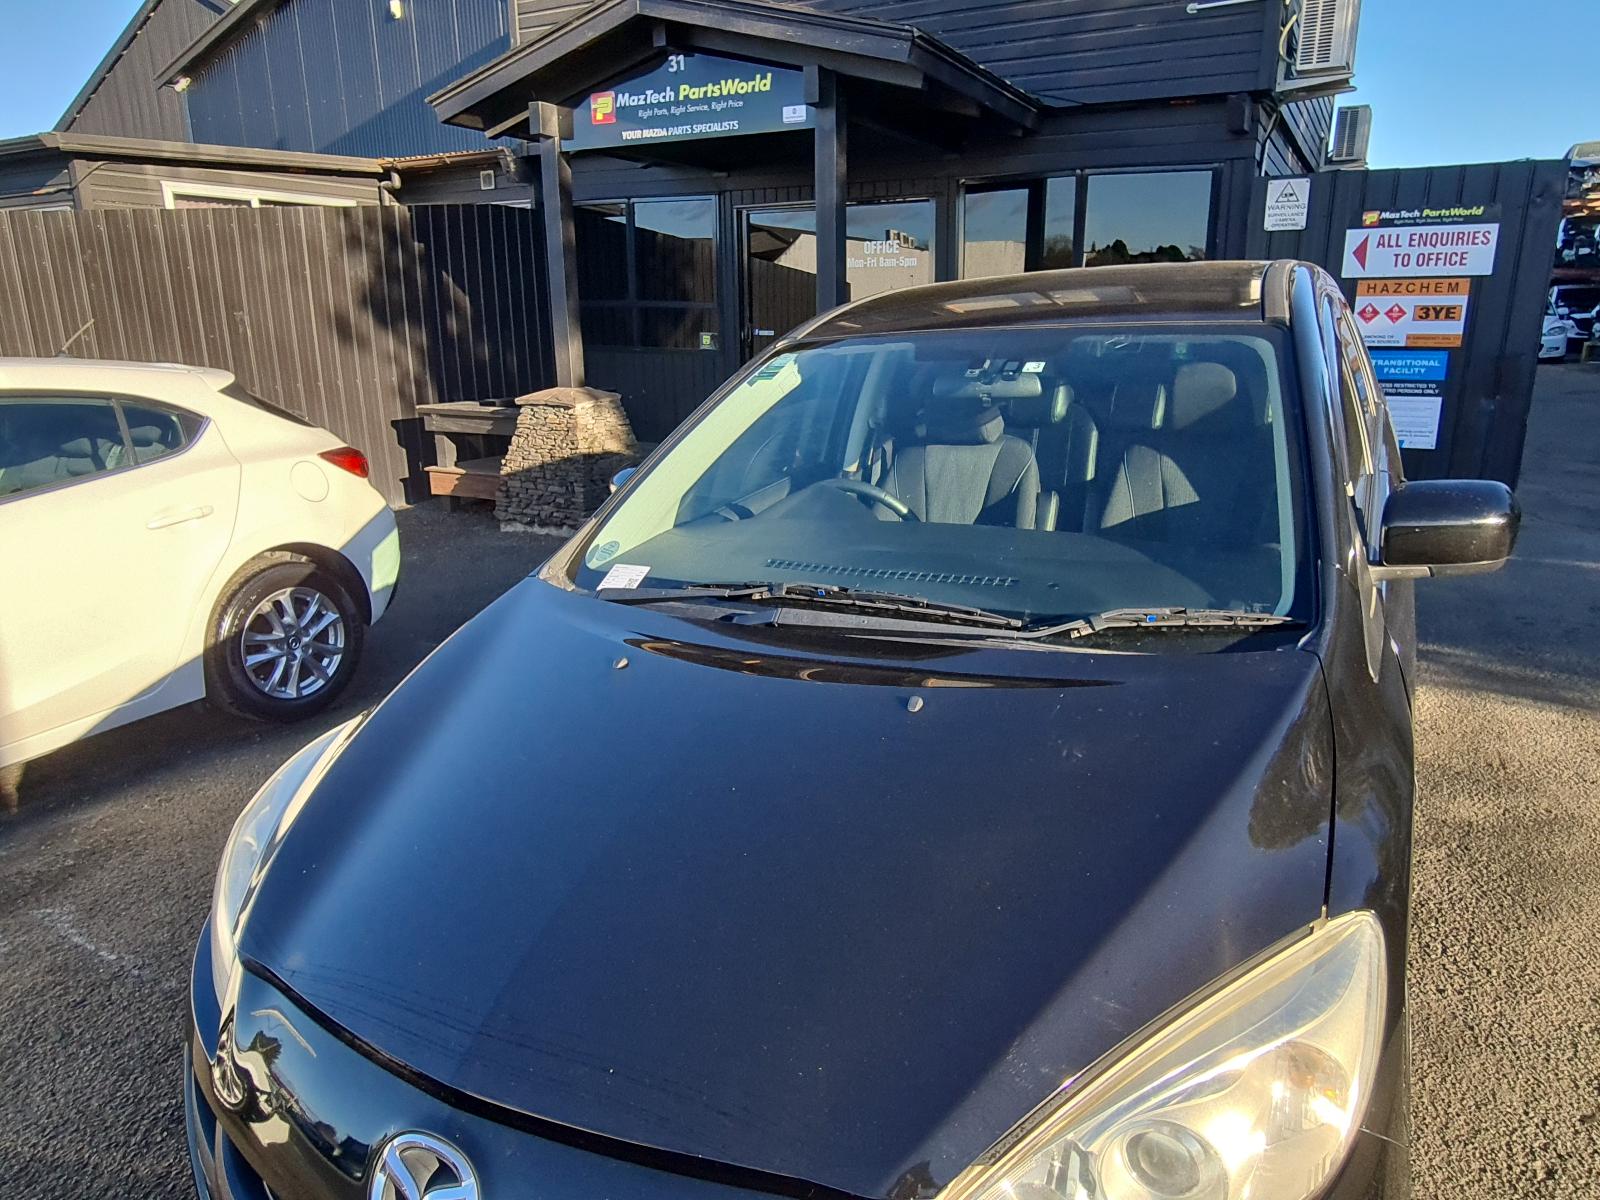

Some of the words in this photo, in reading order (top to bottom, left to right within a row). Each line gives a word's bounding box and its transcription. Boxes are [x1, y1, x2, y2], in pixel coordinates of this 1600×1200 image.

[668, 54, 685, 73] 31
[616, 86, 674, 108] MazTech
[679, 72, 772, 101] PartsWorld
[638, 108, 653, 119] Right
[670, 105, 686, 116] Right
[711, 100, 728, 112] Right
[728, 99, 744, 108] Price
[621, 130, 642, 140] YOUR
[642, 127, 668, 139] MAZDA
[668, 125, 692, 136] PARTS
[692, 120, 739, 134] SPECIALISTS
[1267, 203, 1306, 211] WARNING
[1379, 209, 1420, 219] MazTech
[1422, 206, 1485, 217] PartsWorld
[1376, 233, 1402, 249] ALL
[1408, 230, 1492, 249] ENQUIRIES
[863, 240, 900, 254] OFFICE
[847, 257, 877, 268] Mon-Fri
[879, 256, 917, 268] 8am-5pm
[1393, 253, 1411, 268] TO
[1416, 251, 1469, 267] OFFICE
[1366, 282, 1460, 294] HAZCHEM
[1418, 306, 1457, 320] 3YE
[1371, 359, 1441, 367] TRANSITIONAL
[1383, 367, 1426, 375] FACILITY
